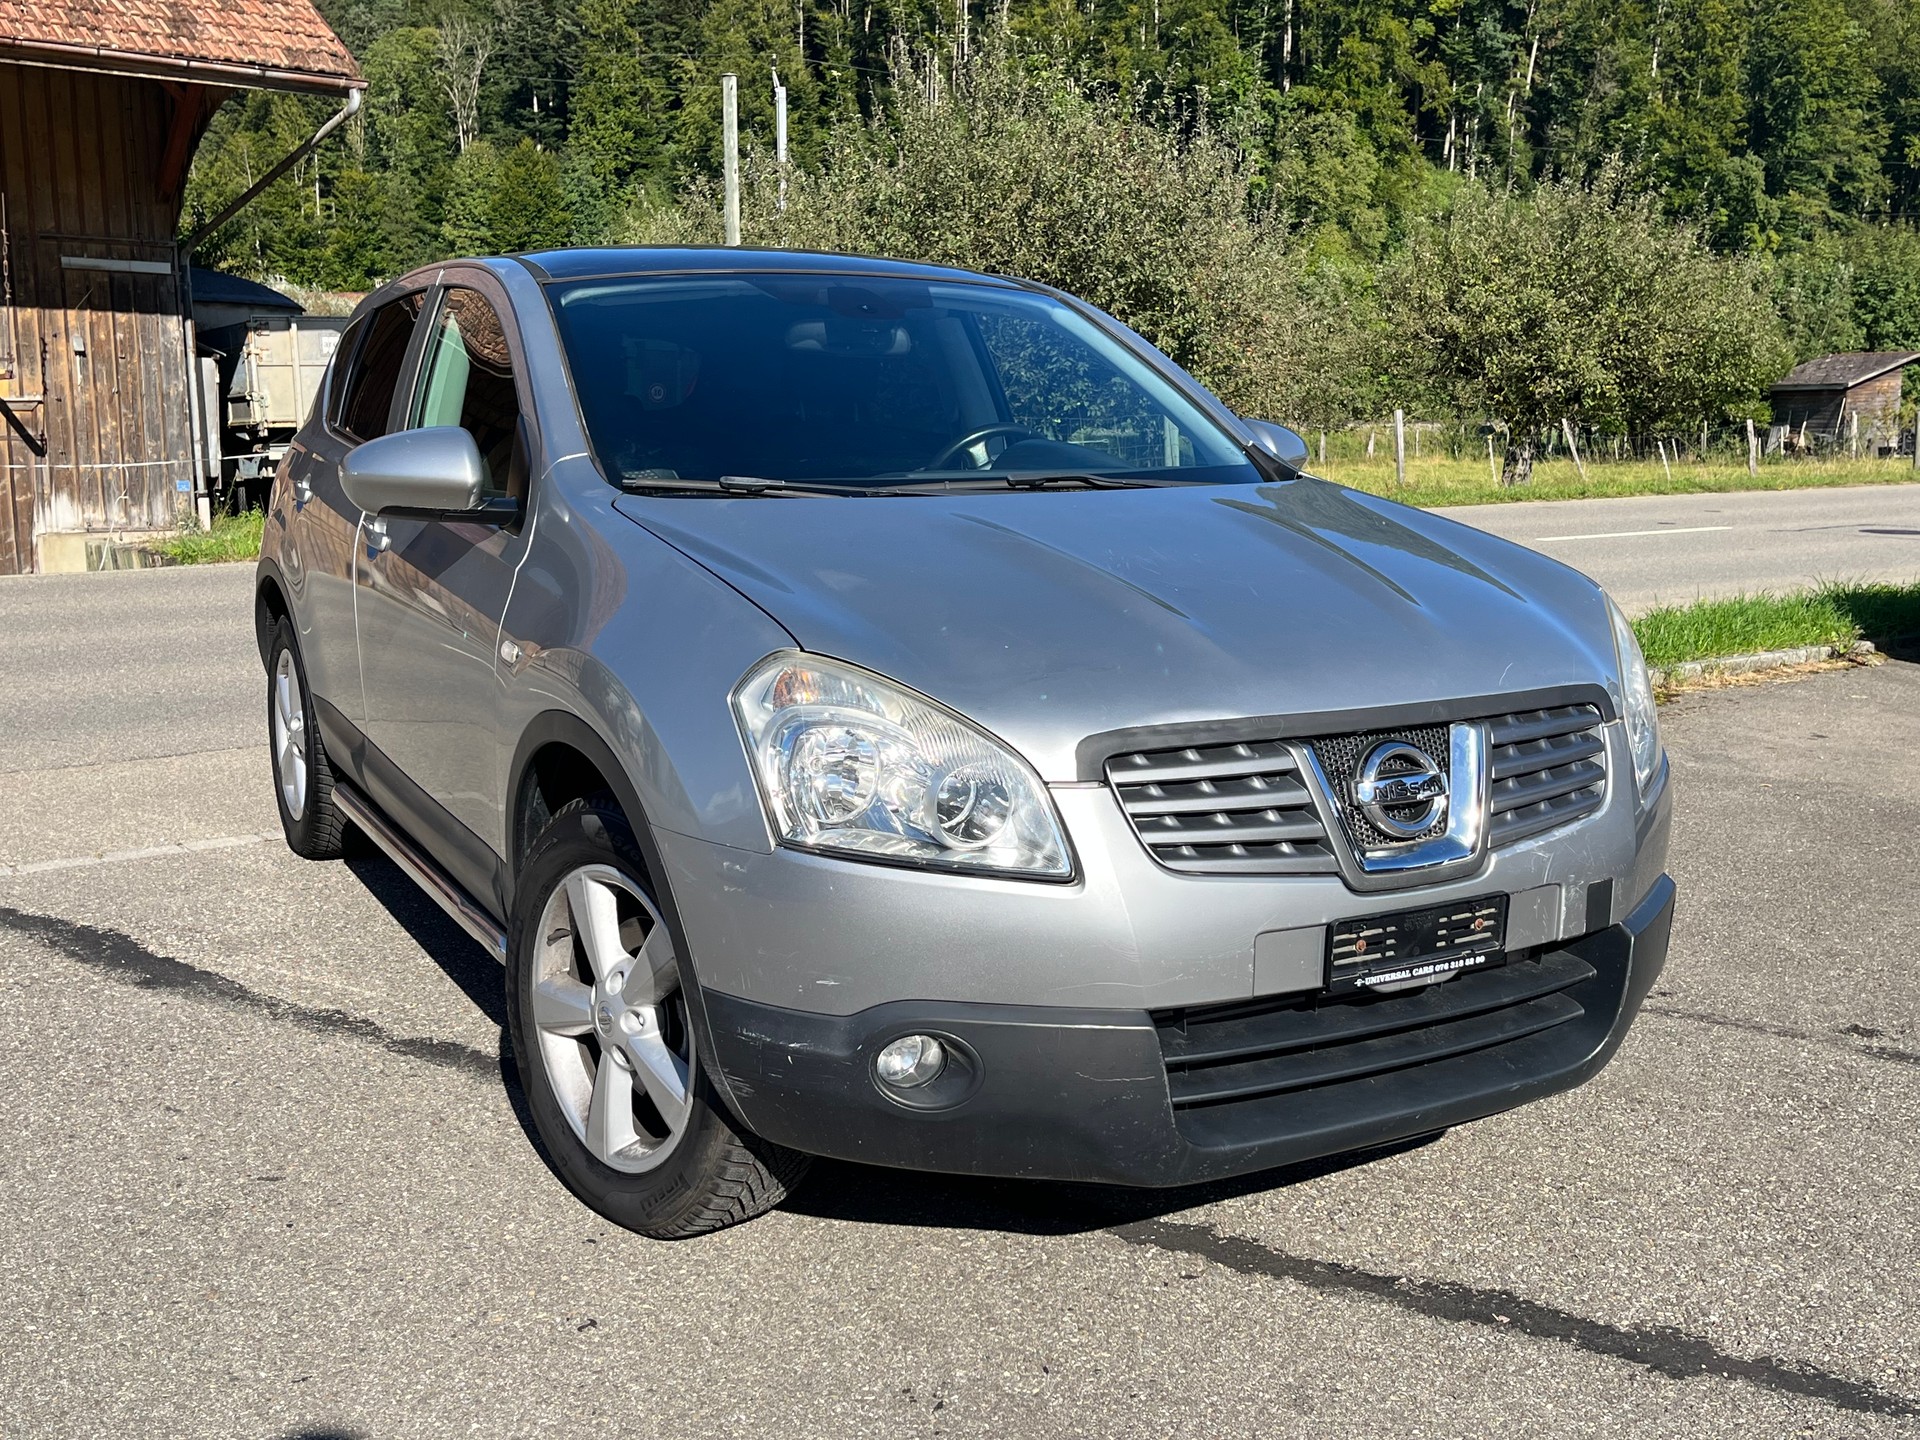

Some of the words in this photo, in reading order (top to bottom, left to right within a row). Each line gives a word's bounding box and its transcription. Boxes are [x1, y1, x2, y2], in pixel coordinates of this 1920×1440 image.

[1374, 778, 1444, 801] NISSAN
[1365, 969, 1411, 985] UNIVERSAL
[1412, 965, 1434, 976] CARS
